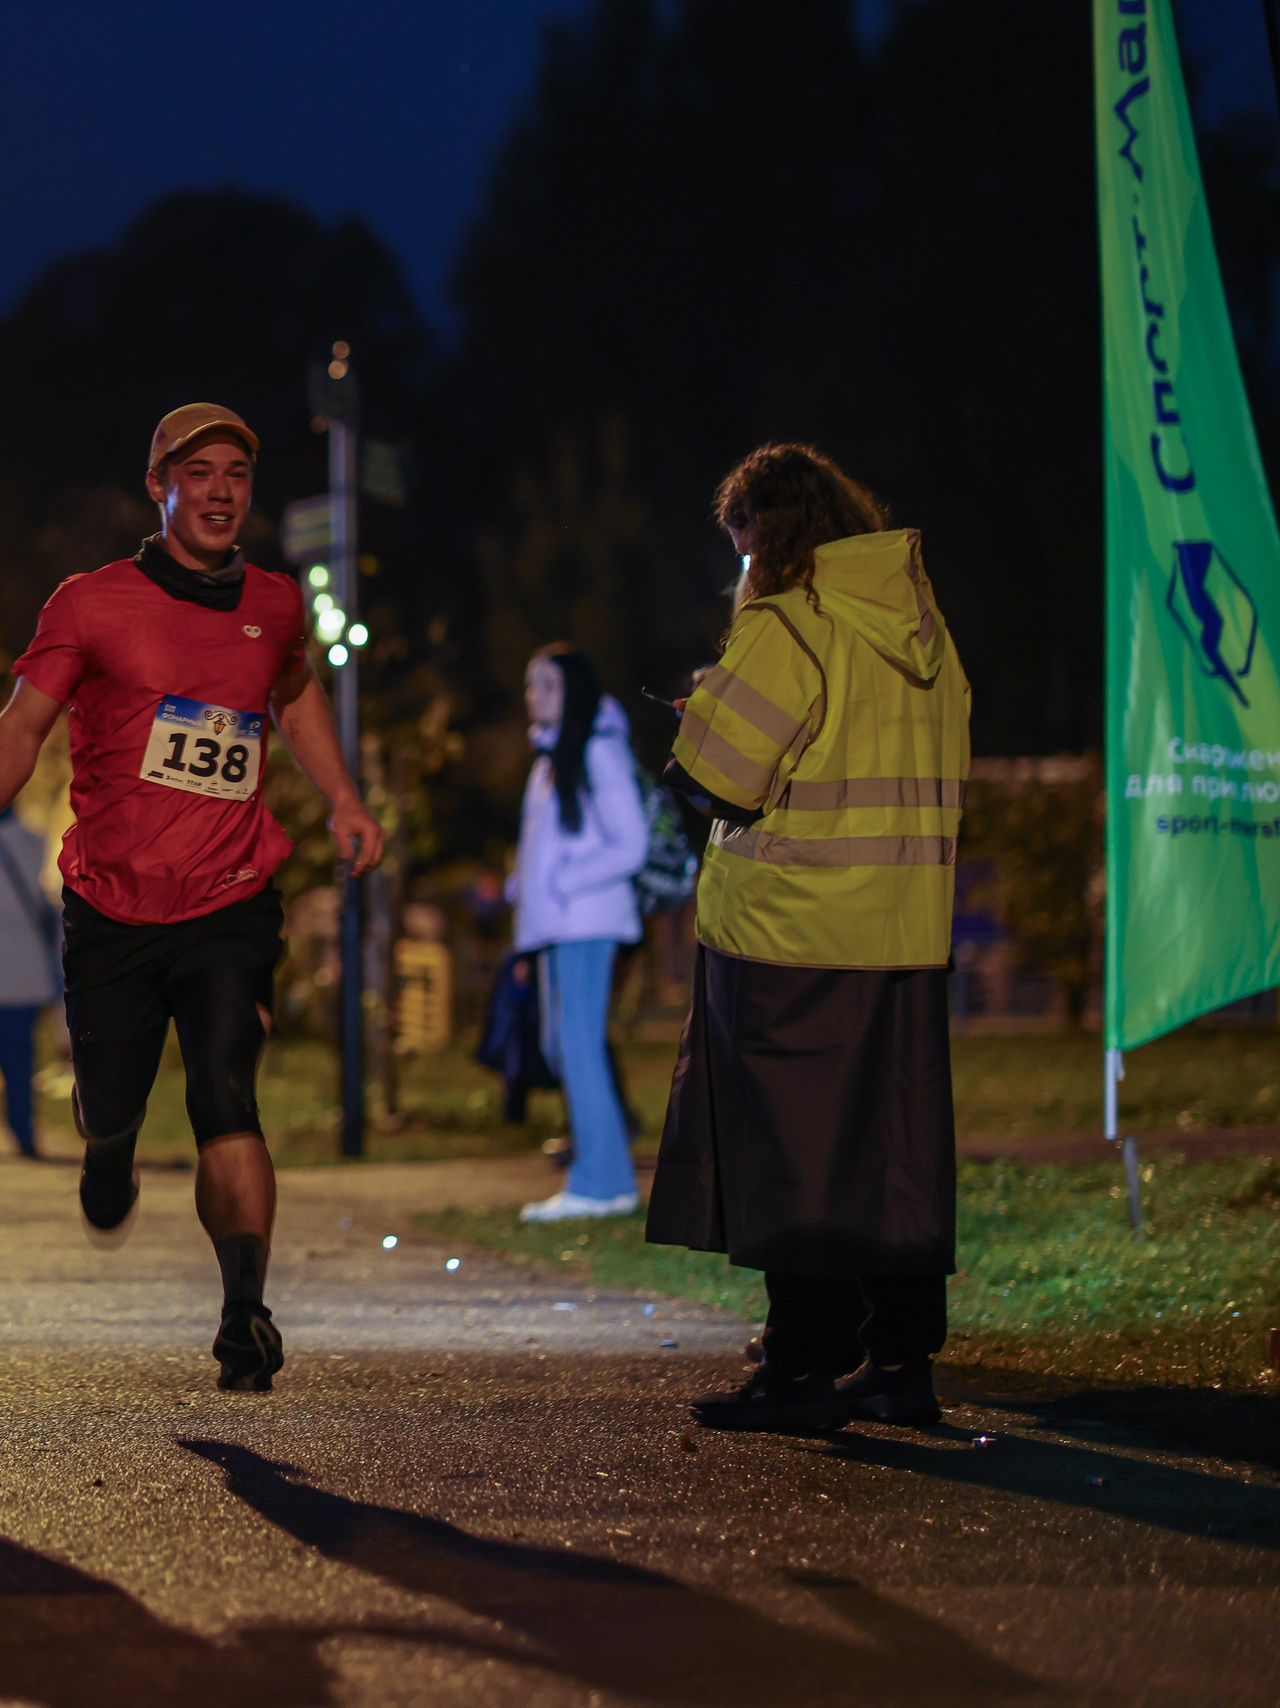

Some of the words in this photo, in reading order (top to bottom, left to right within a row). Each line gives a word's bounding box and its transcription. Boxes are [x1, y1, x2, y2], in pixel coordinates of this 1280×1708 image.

[163, 733, 249, 783] 138
[1125, 774, 1182, 799] для
[1192, 774, 1280, 803] прилю
